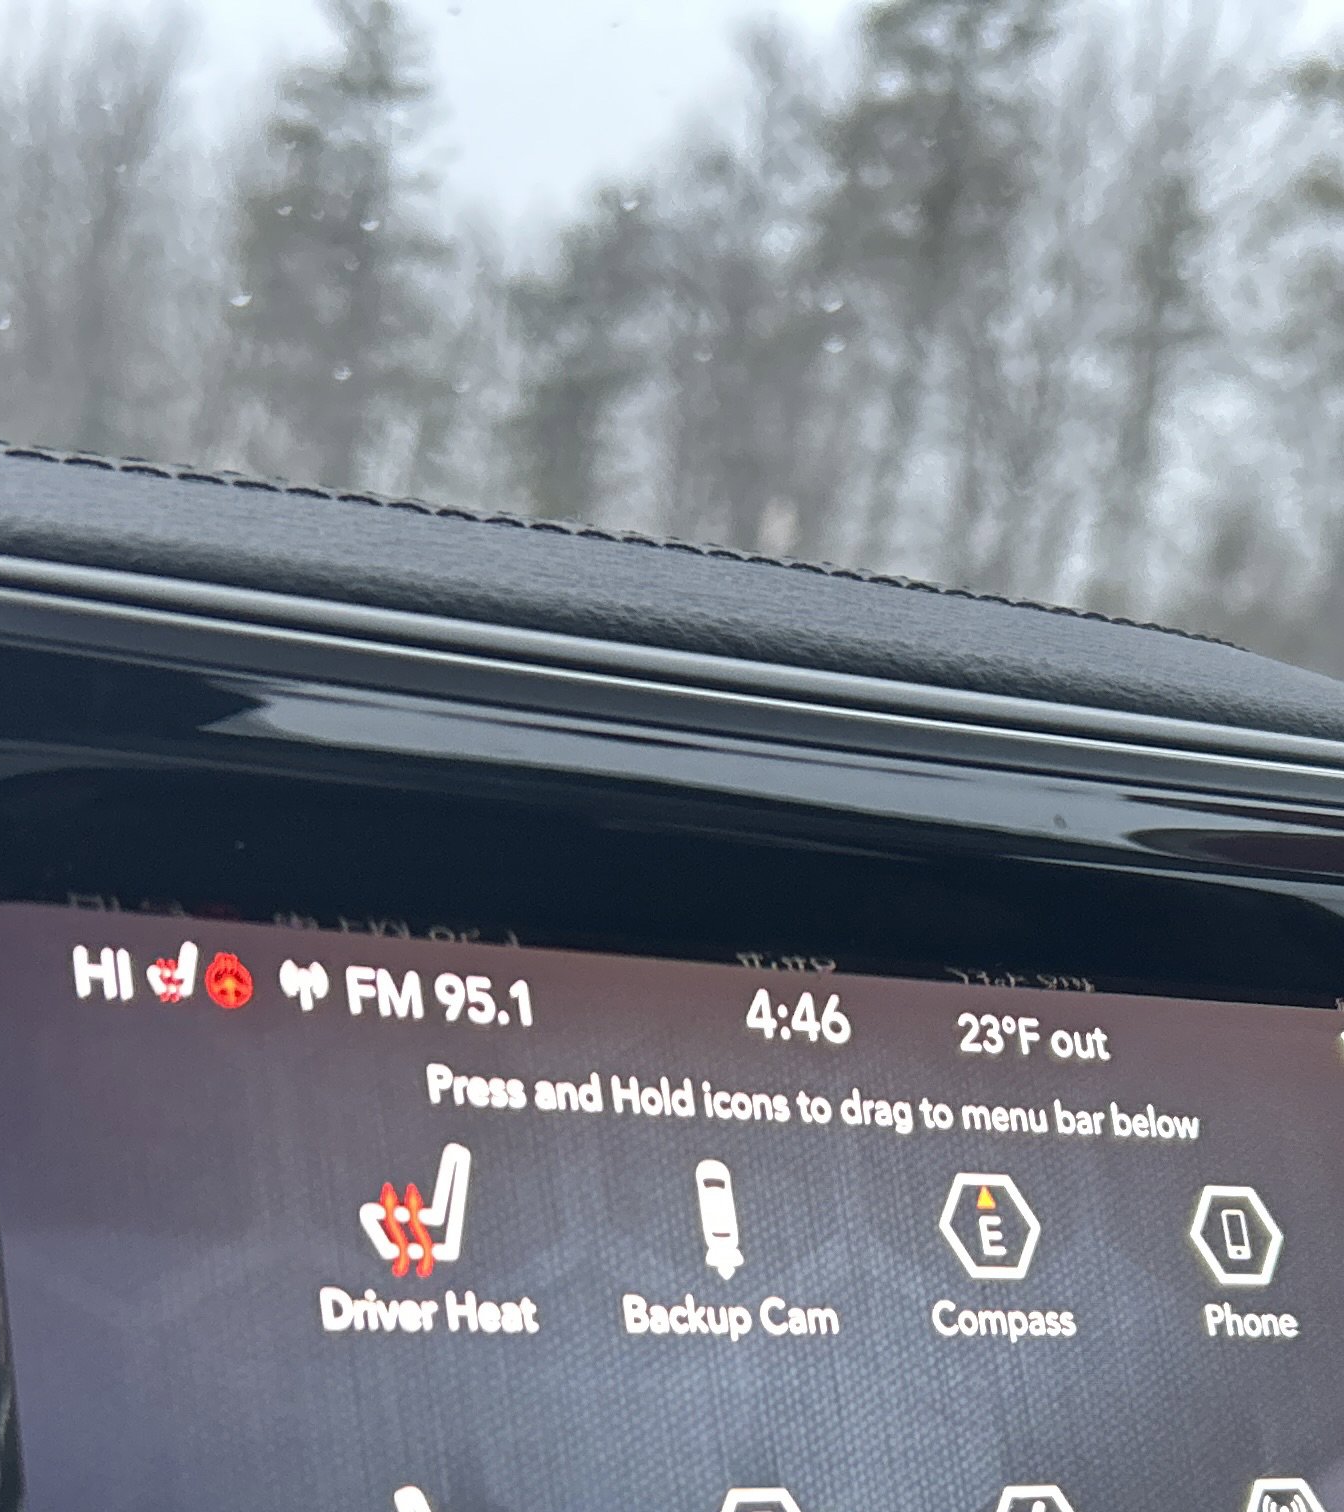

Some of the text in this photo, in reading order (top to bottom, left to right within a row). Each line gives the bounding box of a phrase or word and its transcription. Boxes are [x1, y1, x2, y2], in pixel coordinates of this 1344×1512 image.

[72, 944, 134, 1001] HI
[345, 965, 533, 1027] FM 95.1
[746, 988, 852, 1044] 4:46
[957, 1012, 1111, 1061] 23°F out
[426, 1063, 1200, 1140] Press and Hold icons to drag to menu bar below
[978, 1215, 1007, 1257] E
[319, 1286, 540, 1334] Driver Heat
[622, 1293, 840, 1343] Backup Cam
[931, 1299, 1077, 1344] Compass
[1204, 1301, 1299, 1338] Phone
